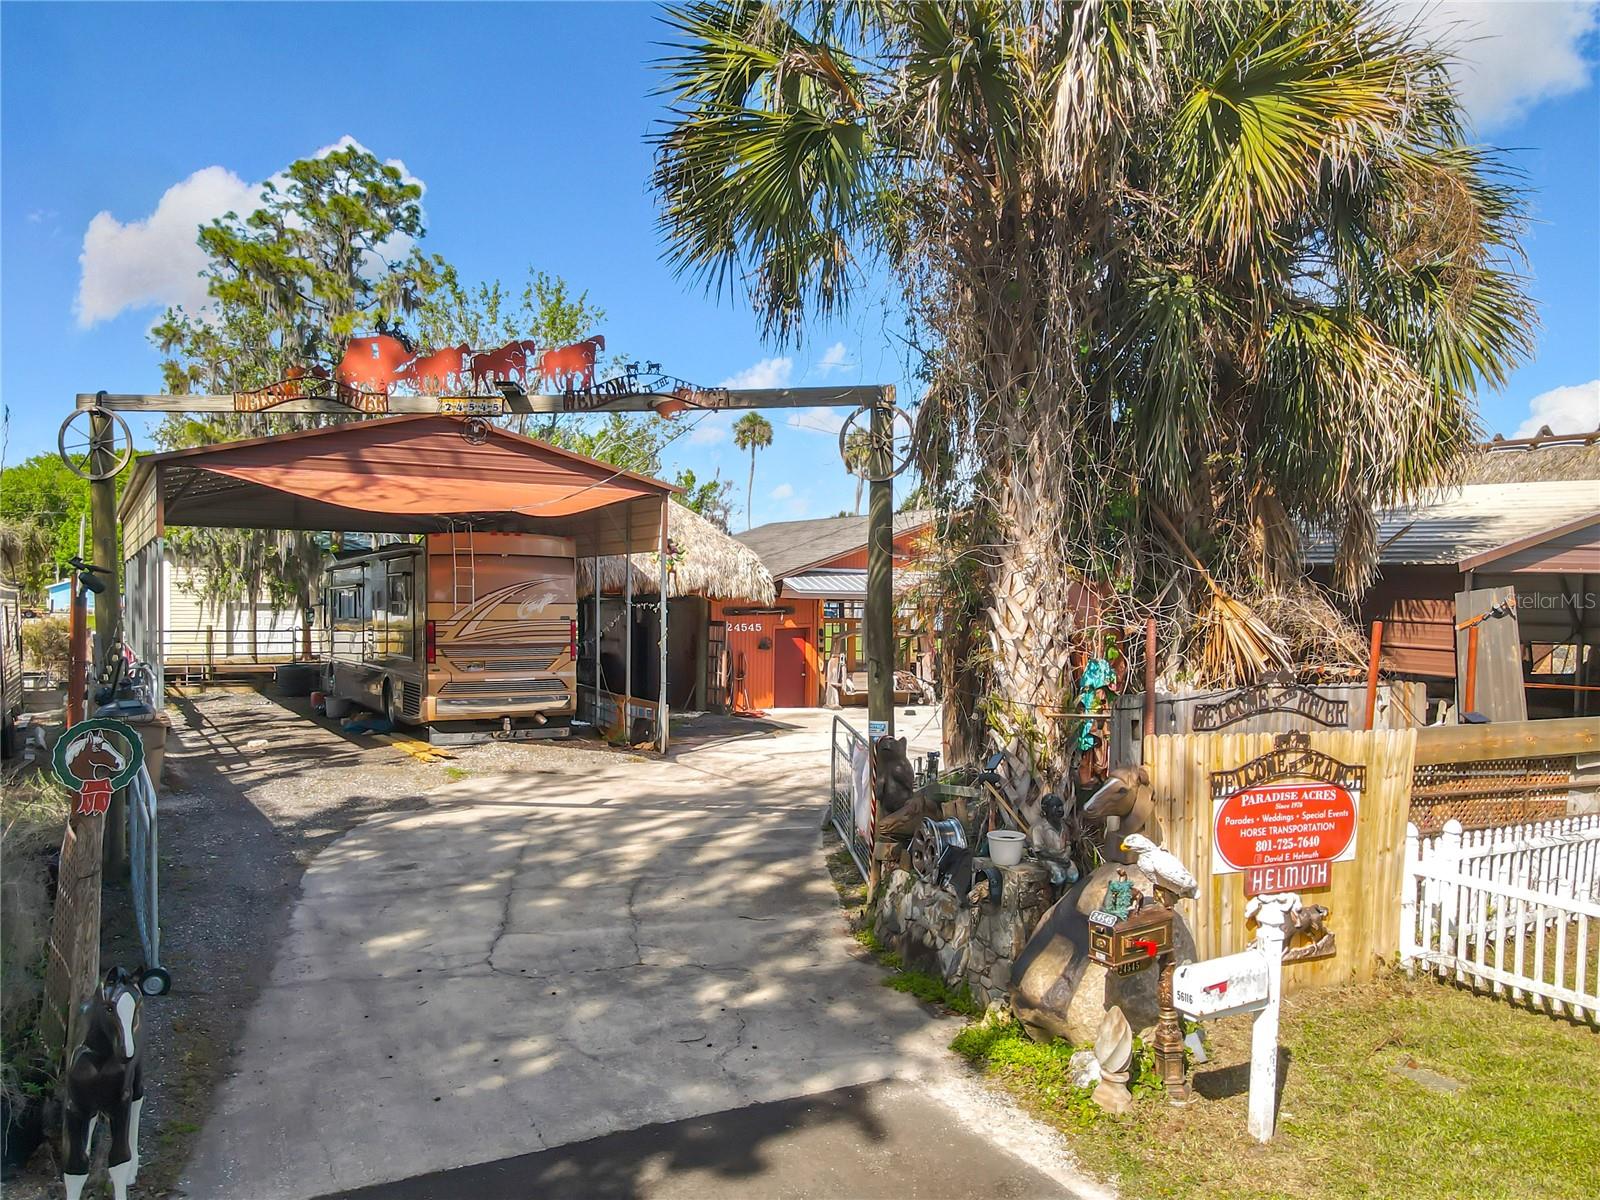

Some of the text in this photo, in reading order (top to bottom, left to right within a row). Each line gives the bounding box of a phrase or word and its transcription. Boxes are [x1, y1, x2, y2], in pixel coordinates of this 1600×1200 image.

[564, 376, 729, 410] WELCOME TO THE RANCH
[727, 623, 762, 632] 24545
[1193, 688, 1269, 728] WELCOME
[471, 730, 534, 741] EAGLE
[1212, 753, 1286, 797] WELCOME
[1312, 754, 1366, 789] RANCH
[1241, 790, 1336, 807] PARADISE ACRES
[1225, 809, 1349, 825] Parades Weddings Special Events
[1240, 822, 1335, 837] HORSE TRANSPORTATION
[1255, 836, 1320, 852] 801-725-7640
[1264, 854, 1284, 863] David
[1293, 851, 1319, 860] Helmuth
[1252, 862, 1327, 891] HELMUTH
[1091, 912, 1115, 926] 24545
[1176, 990, 1194, 1005] 56116
